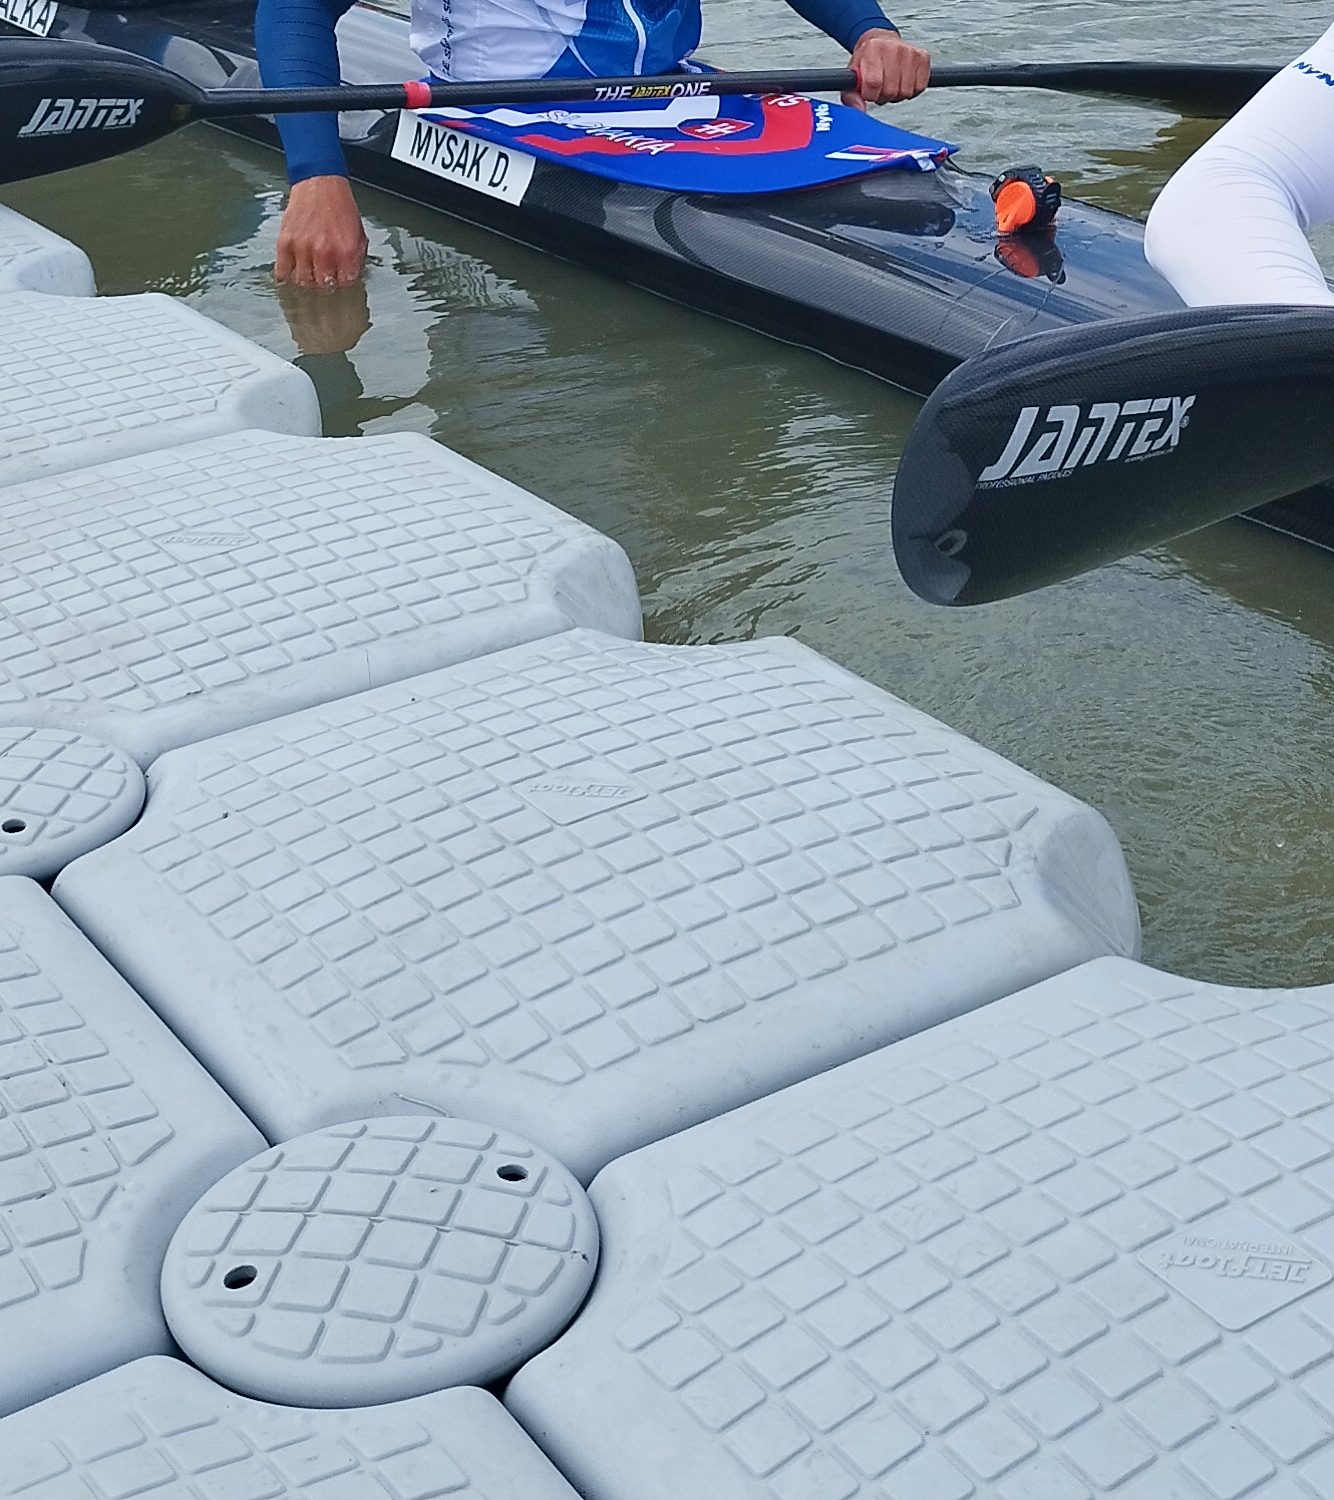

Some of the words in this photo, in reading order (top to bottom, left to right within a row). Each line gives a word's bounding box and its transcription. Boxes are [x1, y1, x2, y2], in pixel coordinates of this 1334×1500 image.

[594, 86, 633, 101] THE
[670, 82, 712, 98] ONE
[409, 121, 490, 182] MYSAK
[487, 150, 510, 192] D.
[1180, 1235, 1295, 1256] INTERNATIONAL
